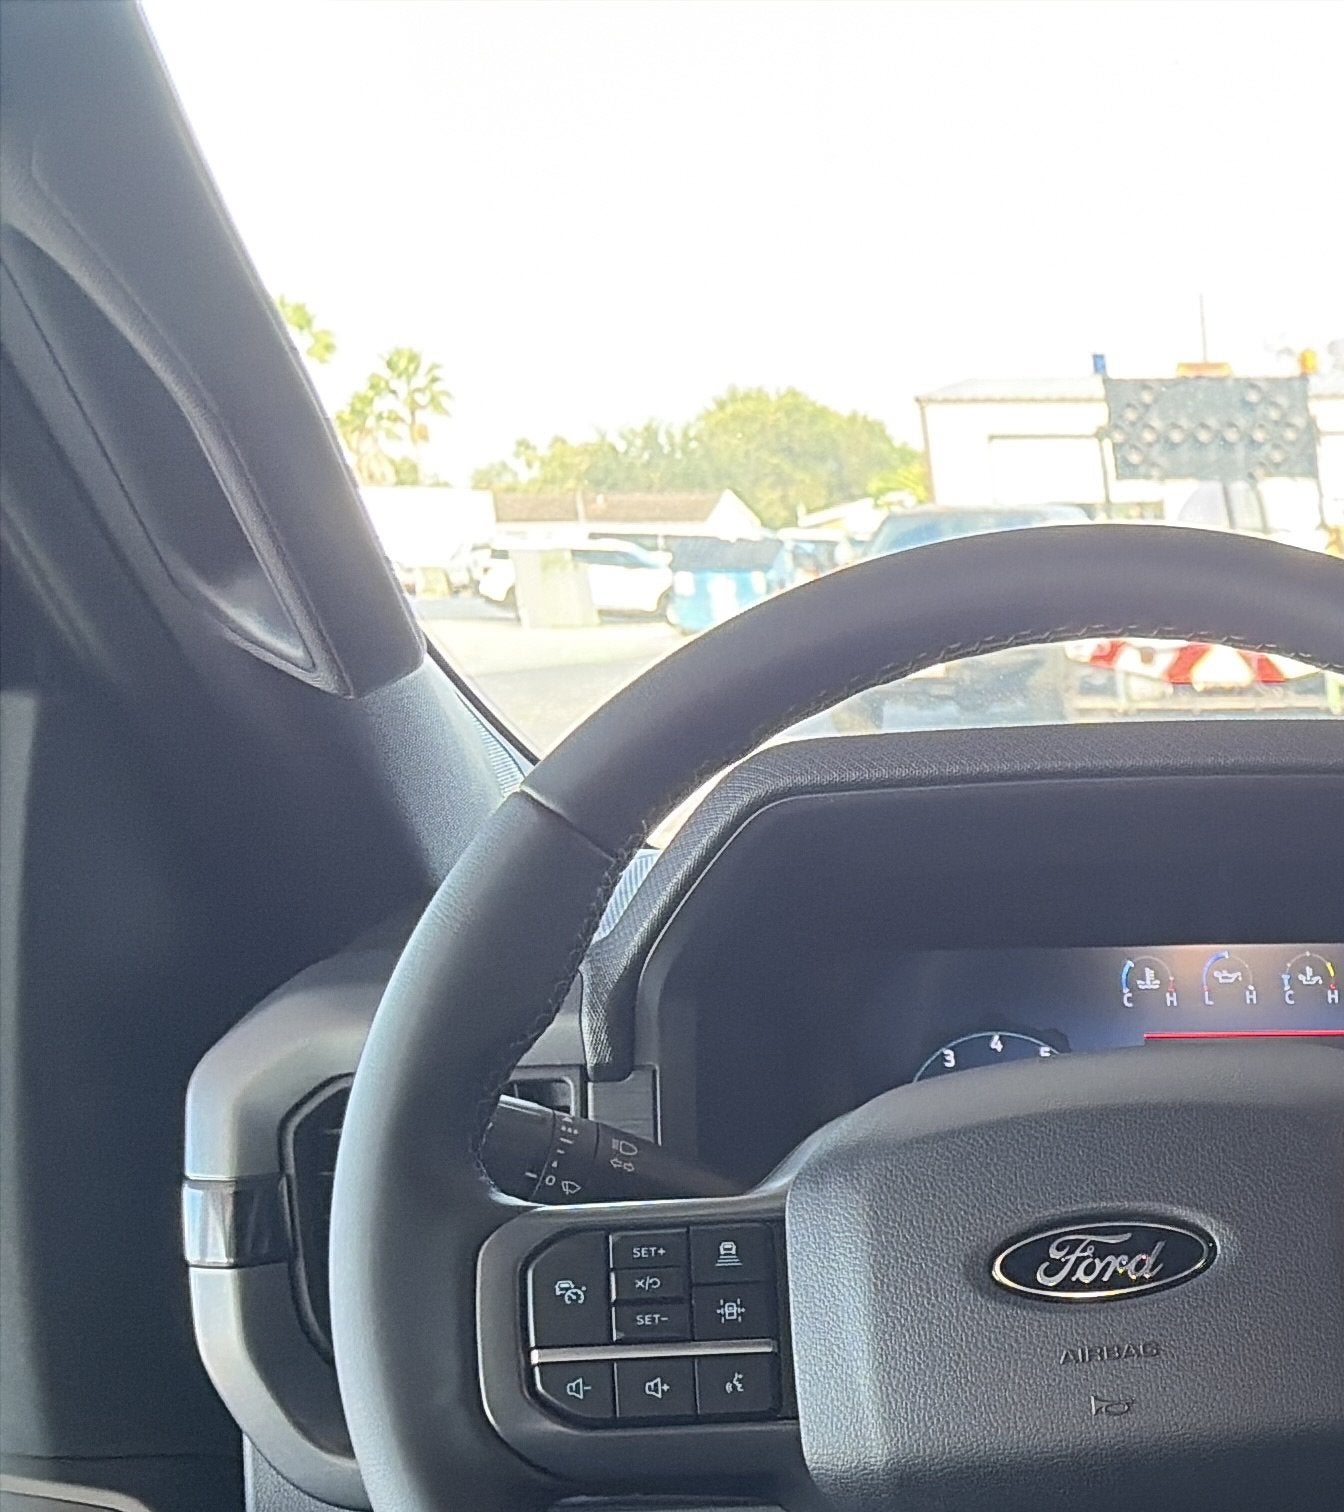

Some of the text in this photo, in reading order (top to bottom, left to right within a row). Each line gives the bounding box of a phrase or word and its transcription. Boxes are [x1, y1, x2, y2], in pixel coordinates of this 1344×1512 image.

[1122, 992, 1178, 1007] C H
[1204, 990, 1257, 1005] L H
[1284, 990, 1339, 1004] C H
[990, 1035, 1003, 1052] 4
[943, 1049, 956, 1068] 3
[1036, 1232, 1167, 1287] Ford
[1059, 1342, 1159, 1365] AIRBAG
